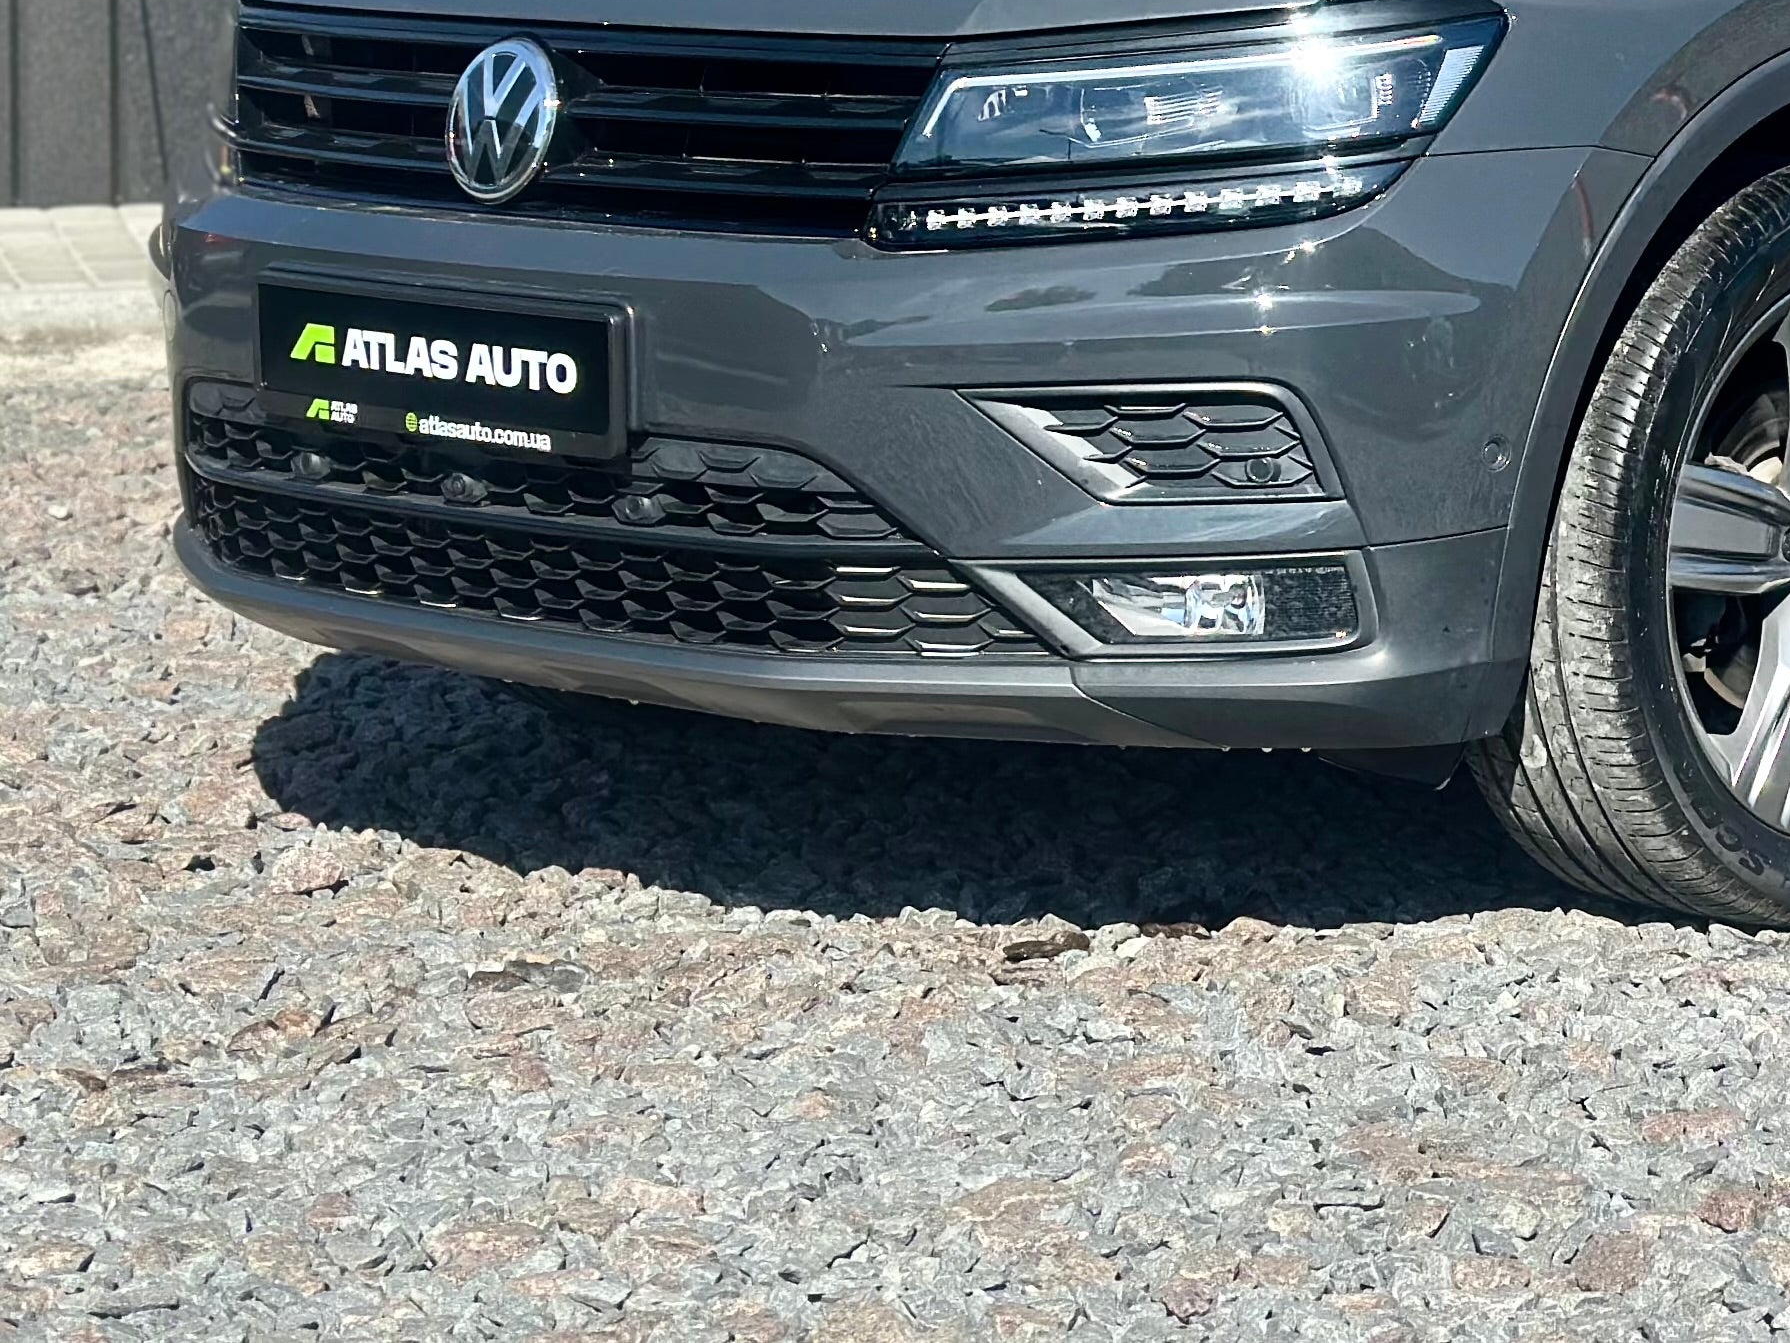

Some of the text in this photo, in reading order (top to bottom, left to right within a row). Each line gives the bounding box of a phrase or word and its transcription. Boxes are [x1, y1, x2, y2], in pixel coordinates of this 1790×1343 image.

[341, 328, 577, 394] ATLAS AUTO
[331, 400, 358, 414] ATLAS
[331, 411, 355, 423] AUTO
[418, 414, 551, 452] atlasauto.com.ua
